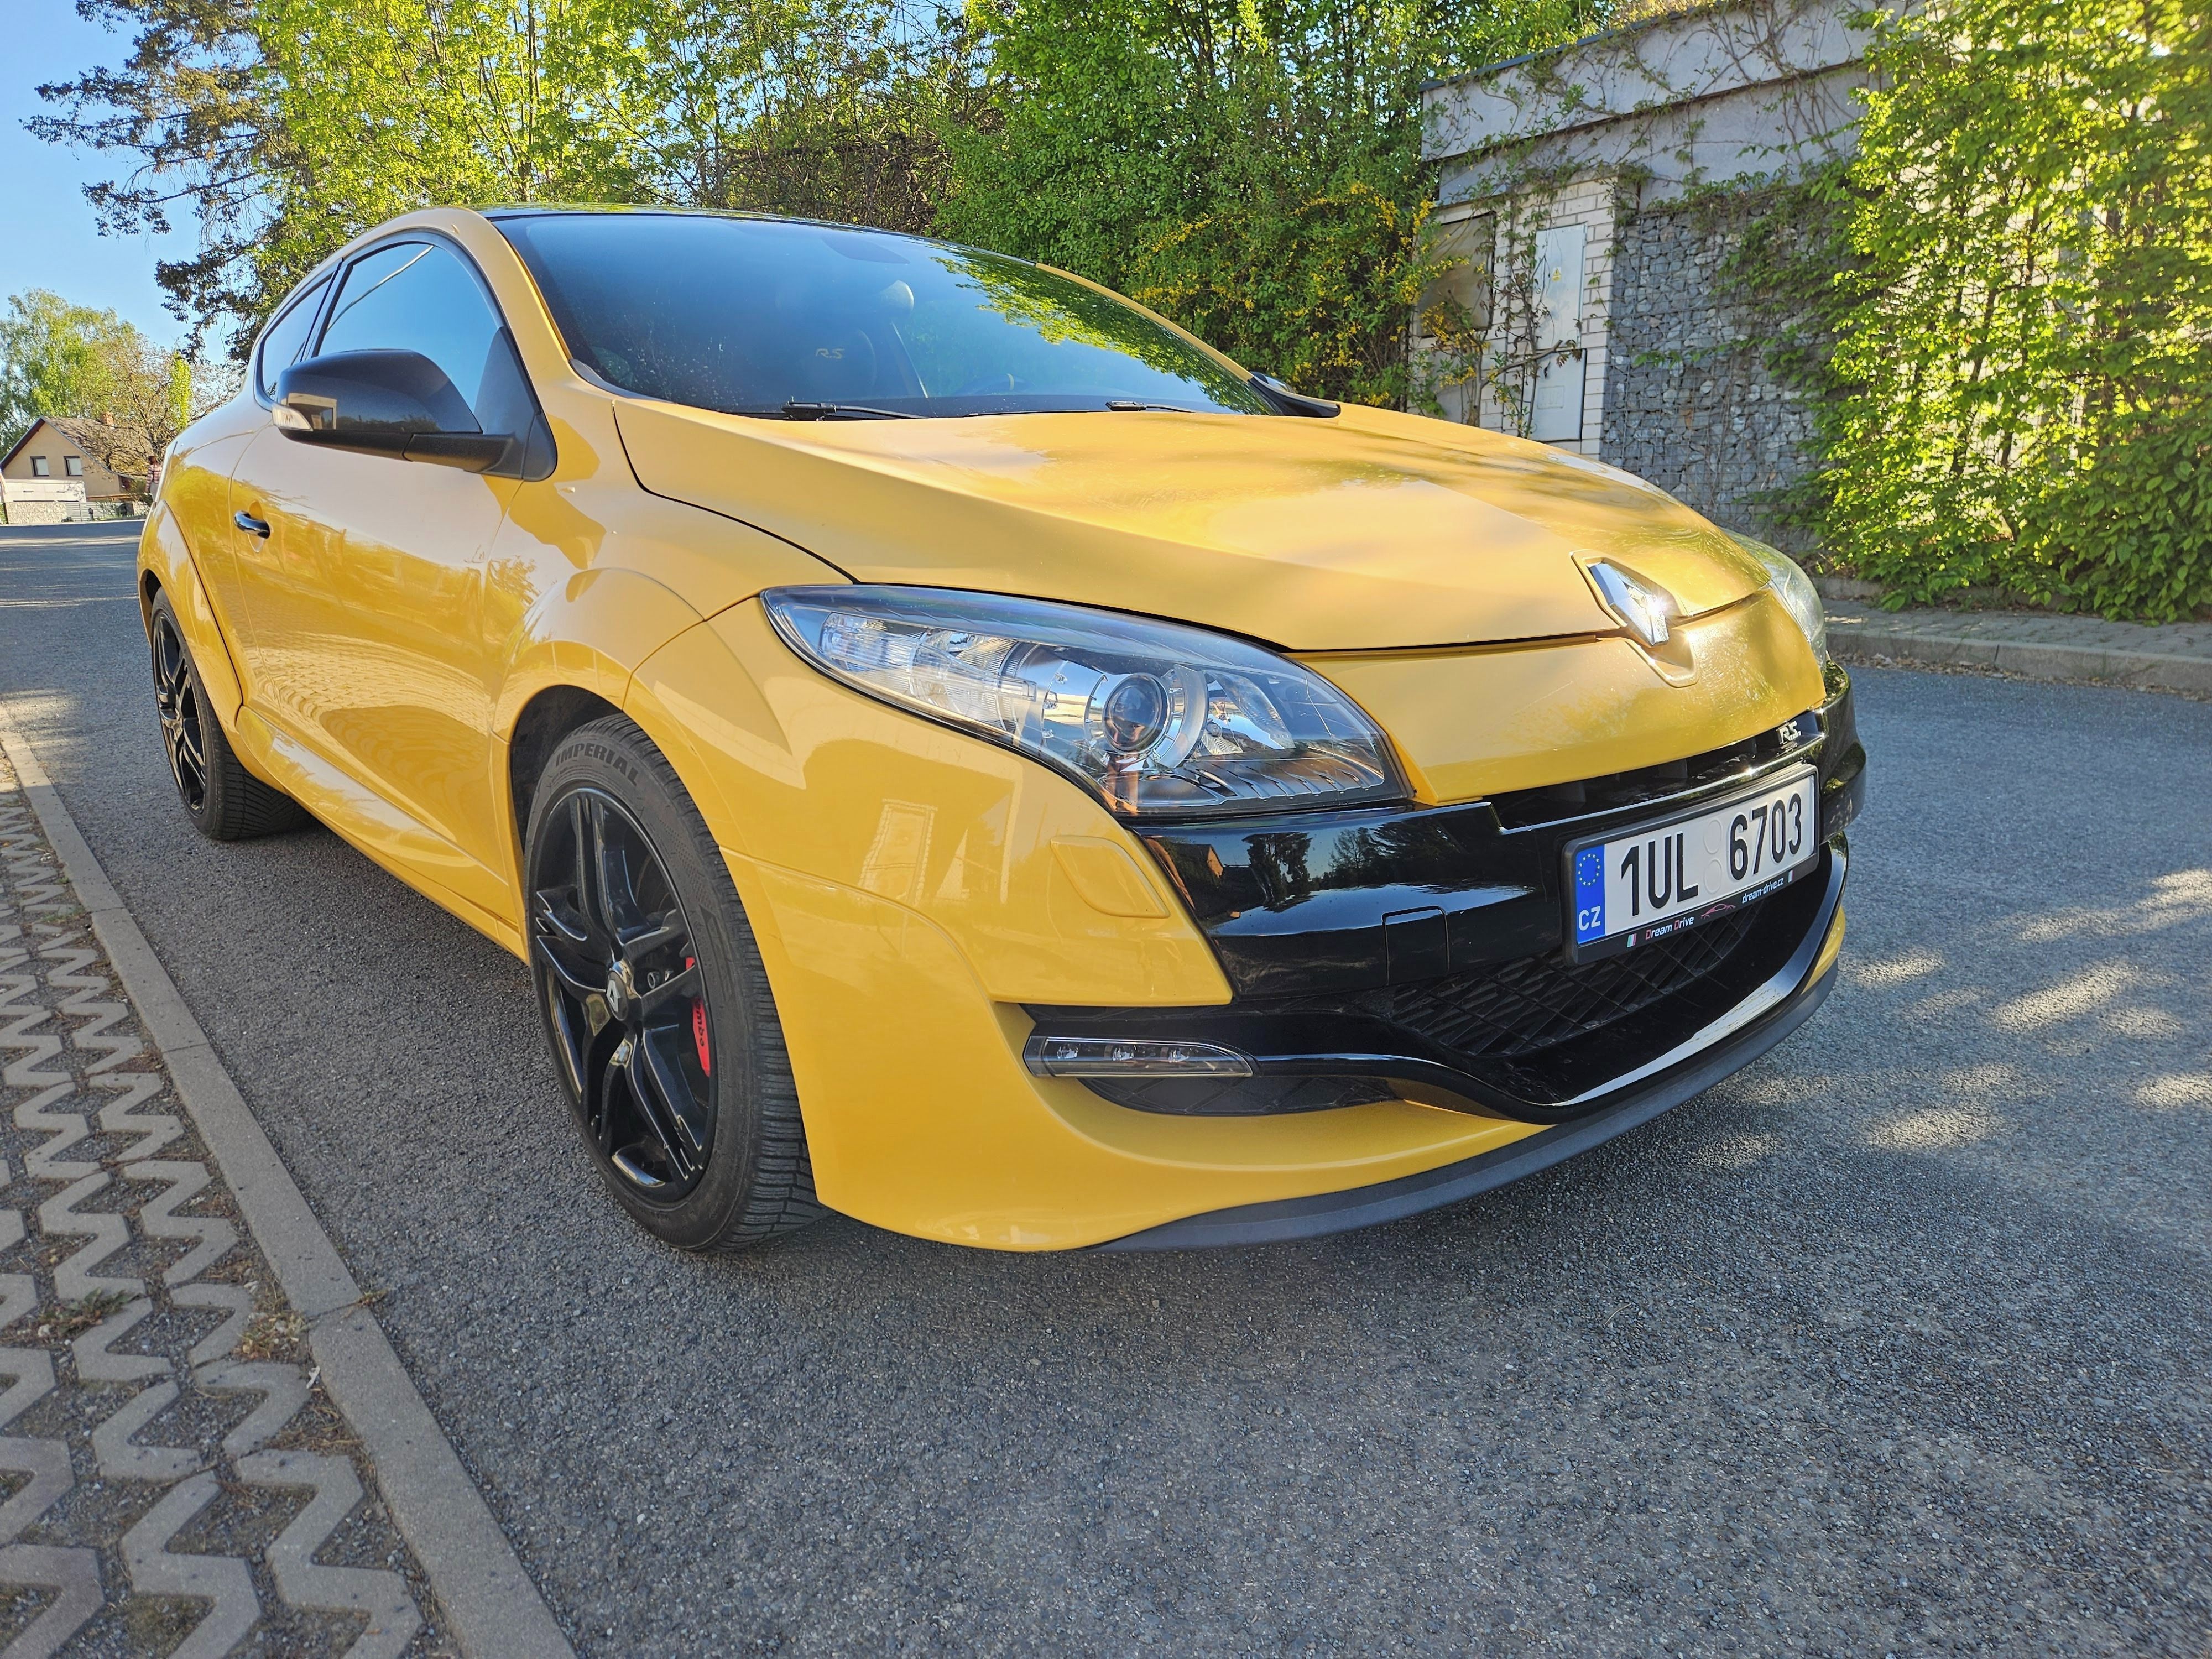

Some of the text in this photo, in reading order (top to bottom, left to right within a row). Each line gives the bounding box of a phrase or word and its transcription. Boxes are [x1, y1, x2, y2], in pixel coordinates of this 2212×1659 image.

[556, 743, 638, 787] IMPERIAL
[1621, 793, 1802, 916] 1UL 6703
[1742, 878, 1784, 904] dream-drive.cz
[1579, 905, 1601, 931] CZ
[1645, 916, 1694, 940] Dream Drive
